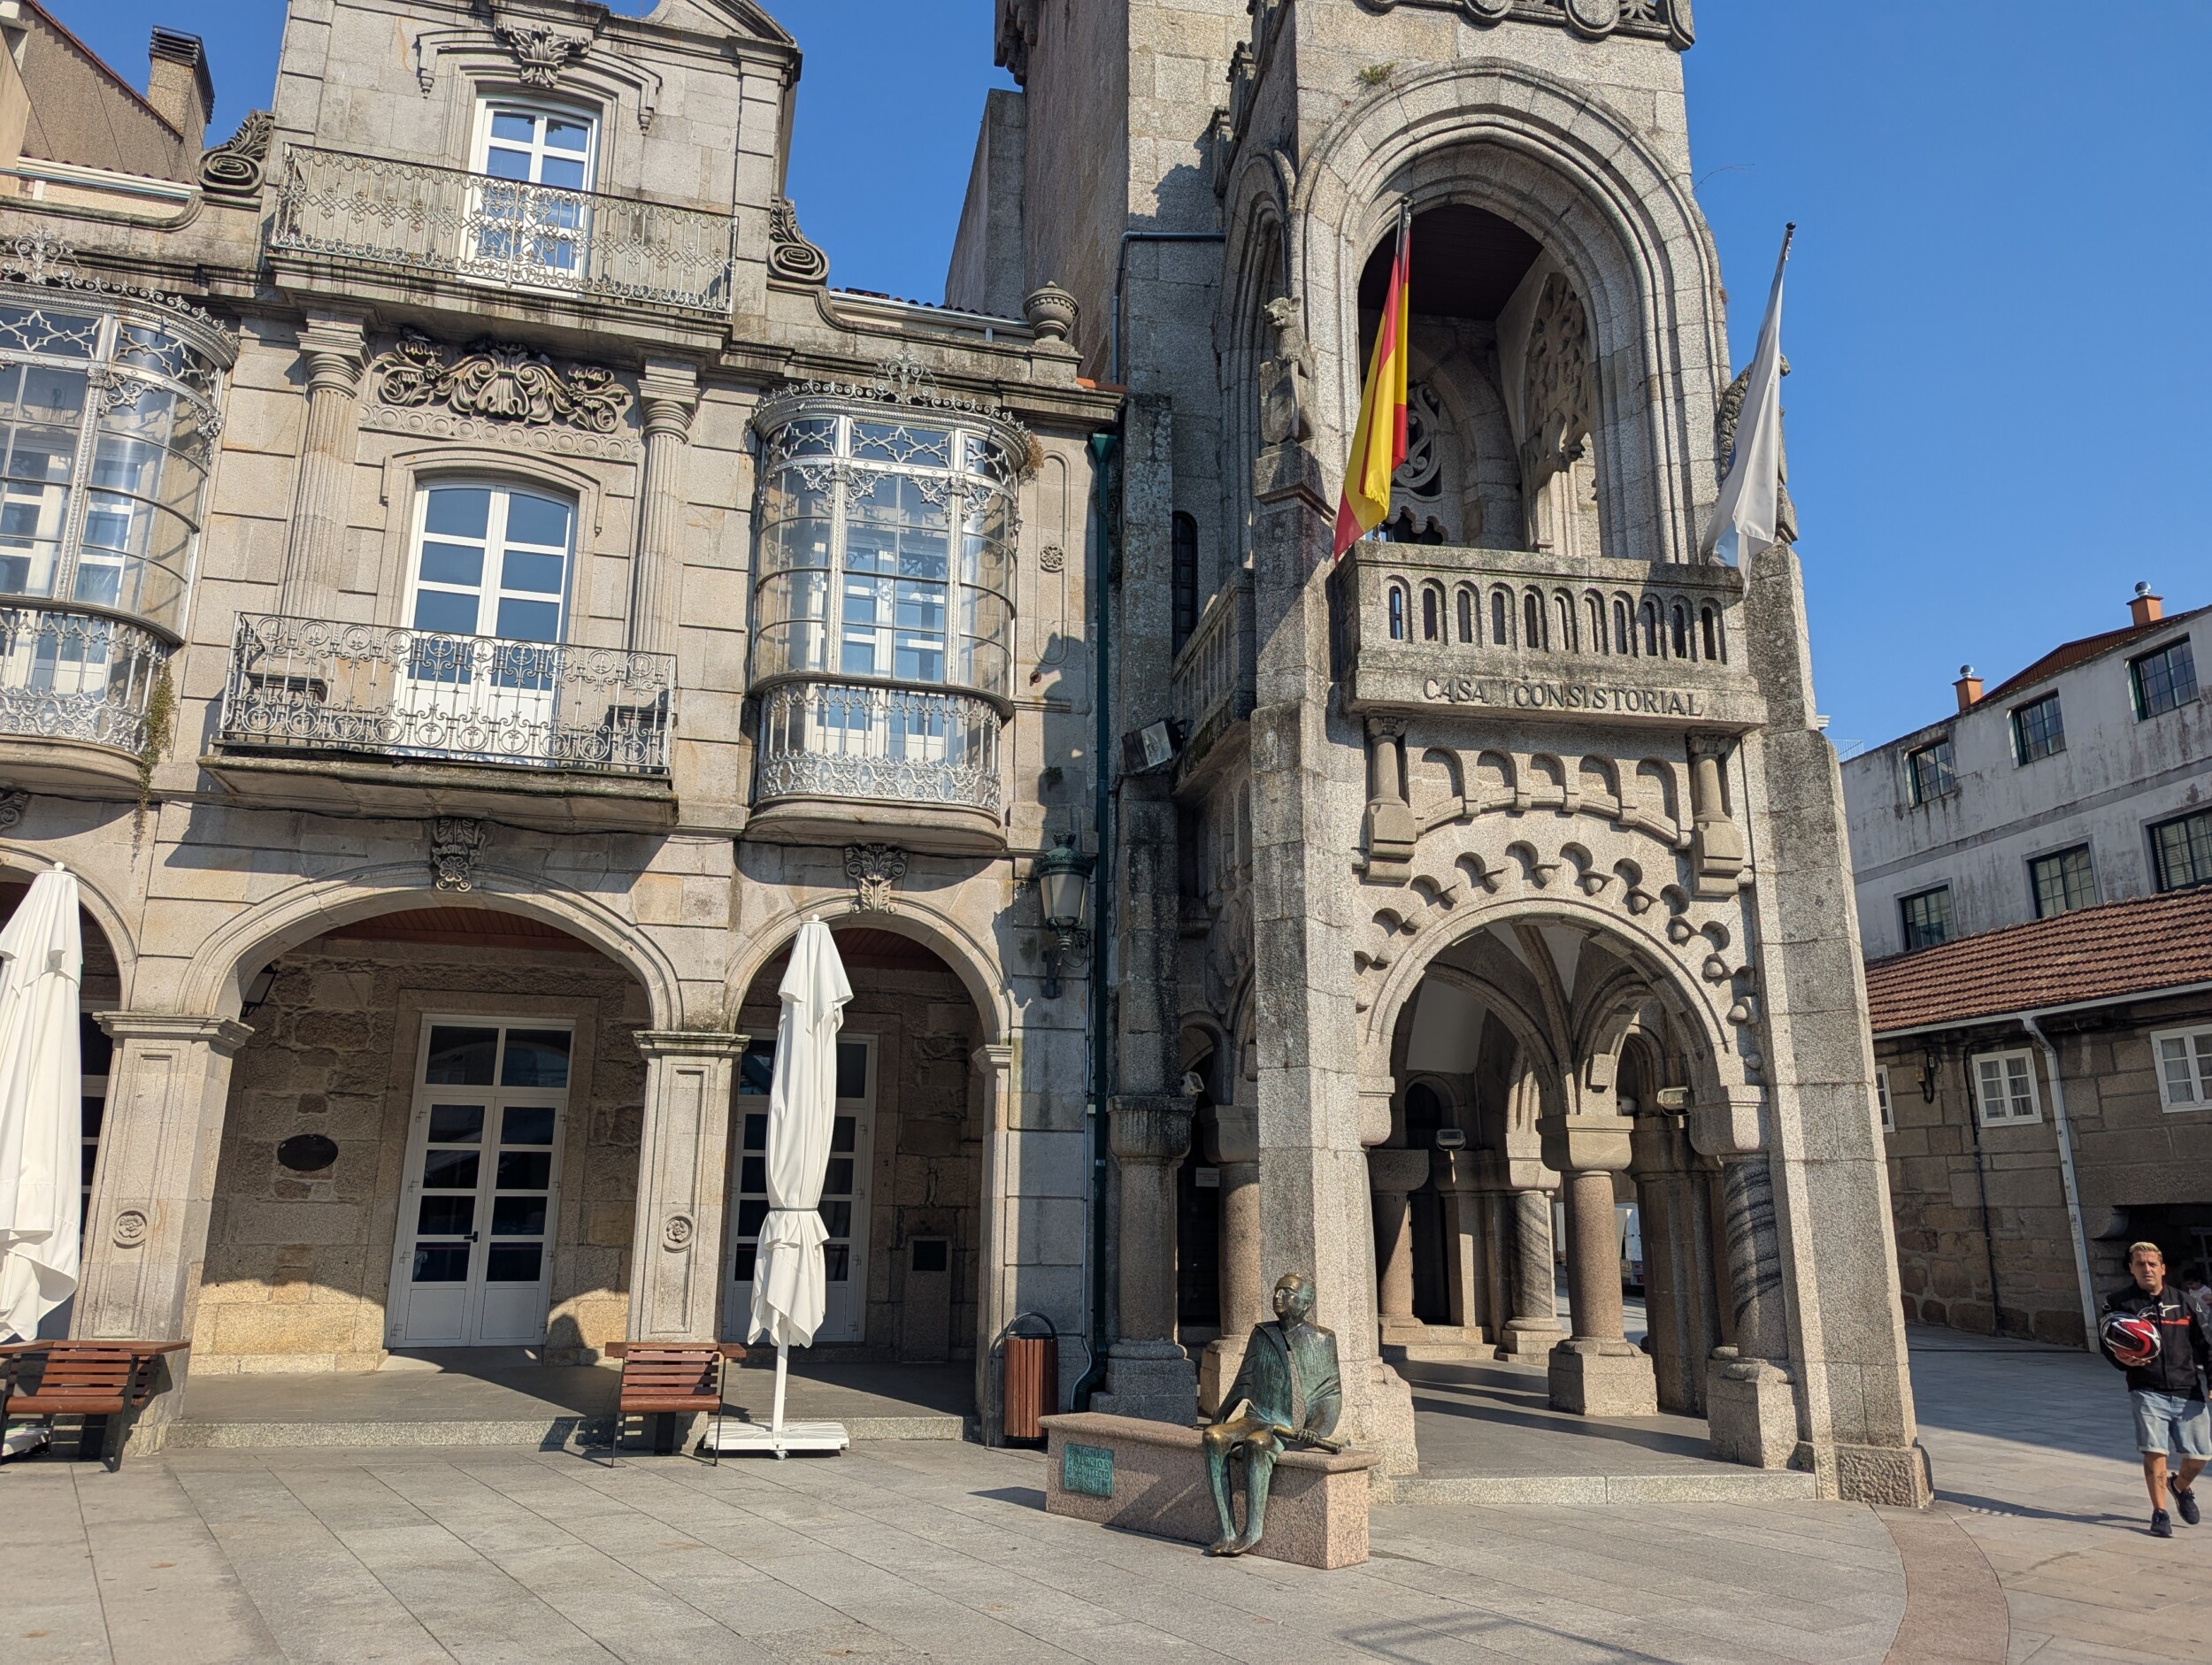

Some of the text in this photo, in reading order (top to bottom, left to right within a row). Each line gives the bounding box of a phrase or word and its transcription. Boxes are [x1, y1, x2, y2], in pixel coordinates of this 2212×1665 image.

[1423, 678, 1704, 717] CASA CONSISTORIAL
[1070, 1446, 1105, 1459] ANTONIO
[1069, 1454, 1109, 1469] PALACIOS
[1068, 1464, 1110, 1479] ARQUITECTO
